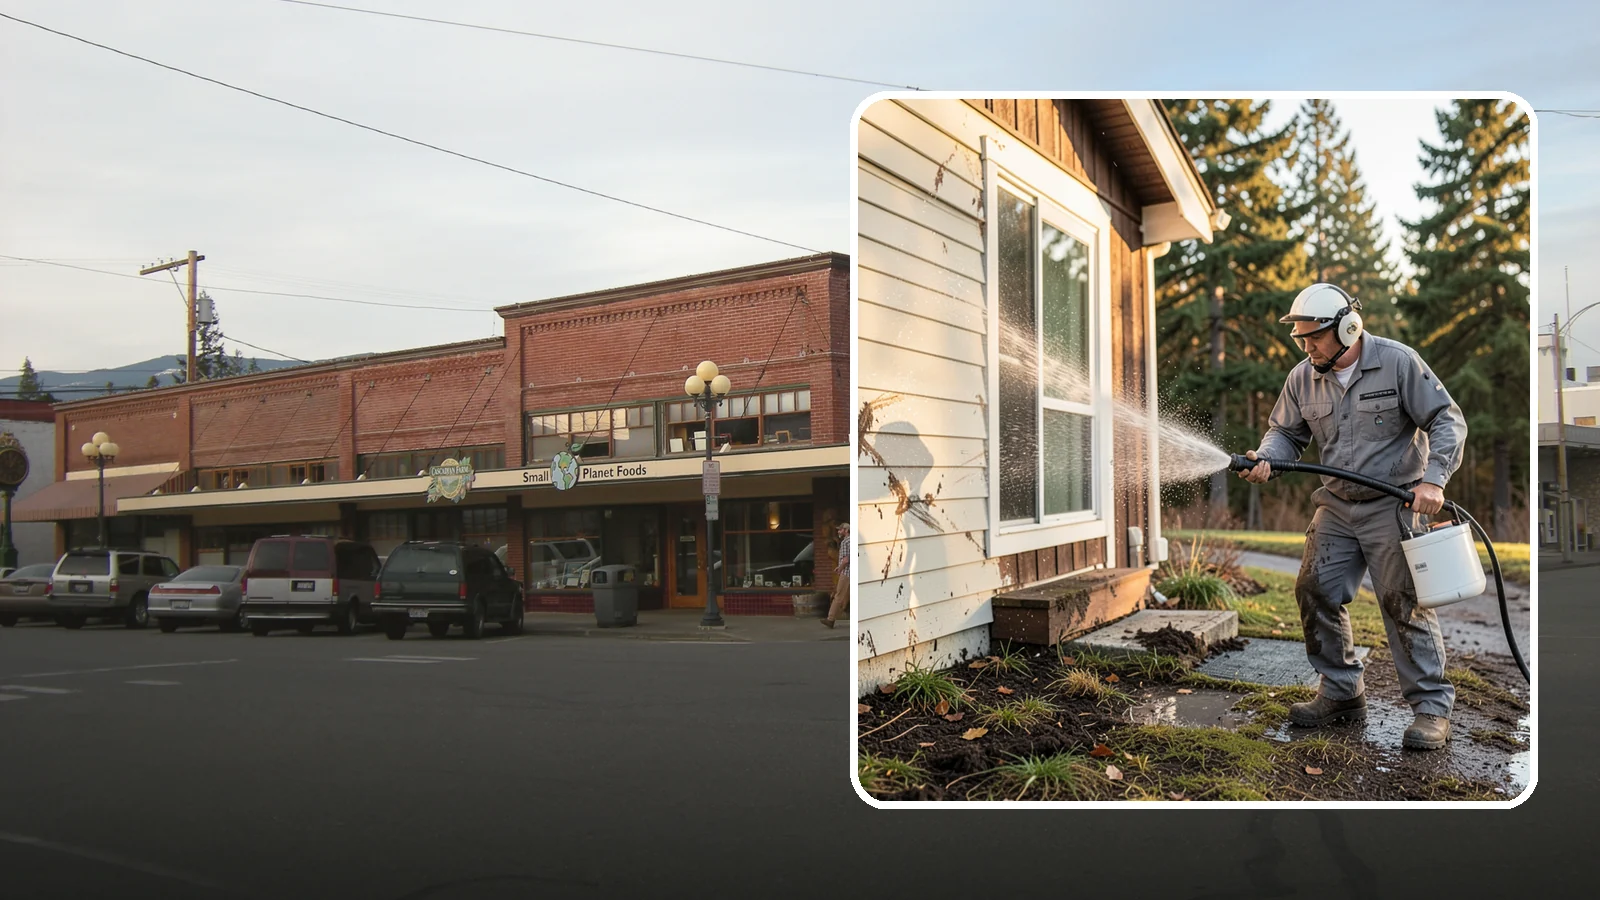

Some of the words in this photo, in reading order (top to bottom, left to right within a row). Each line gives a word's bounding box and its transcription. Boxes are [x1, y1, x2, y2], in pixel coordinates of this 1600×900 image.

[523, 471, 549, 483] Small
[583, 468, 614, 479] Planet
[617, 464, 647, 476] Foods
